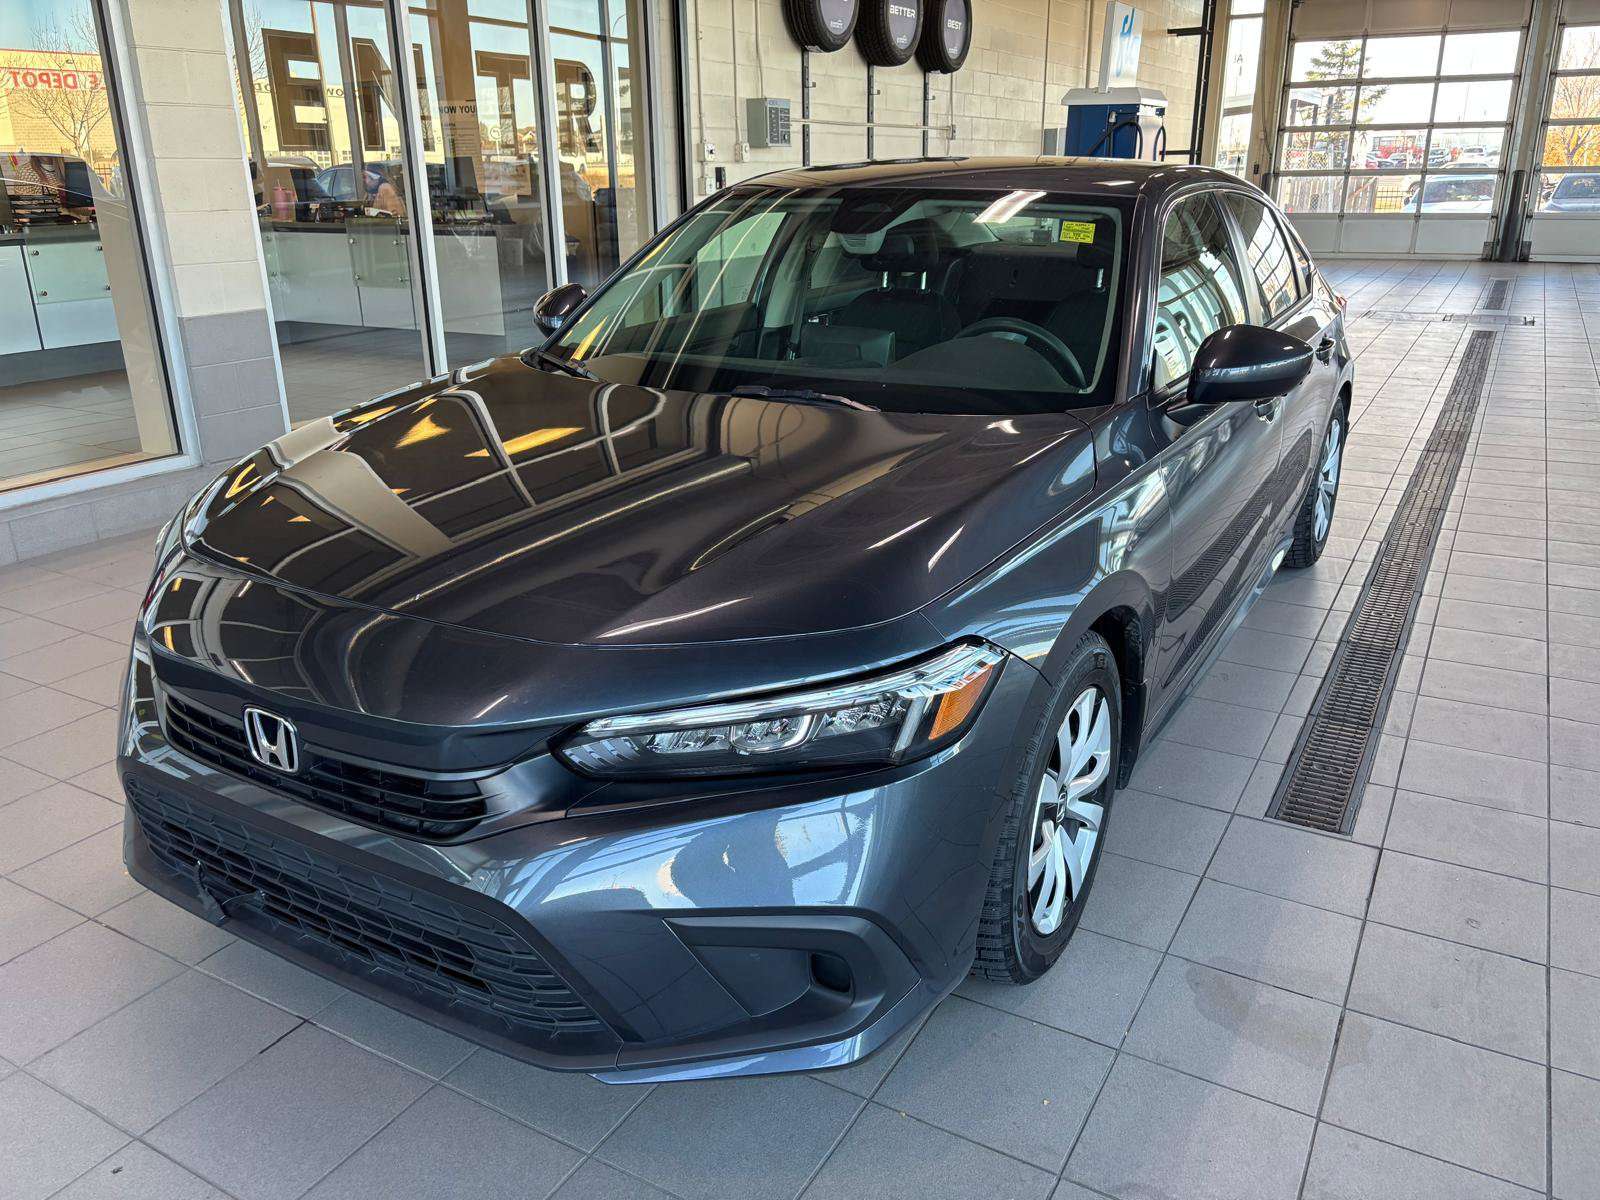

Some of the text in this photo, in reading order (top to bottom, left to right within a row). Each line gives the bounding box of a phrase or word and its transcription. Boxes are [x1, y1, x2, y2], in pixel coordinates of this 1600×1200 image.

[889, 4, 916, 18] BETTER
[947, 19, 962, 30] BEST
[459, 104, 477, 114] YOU
